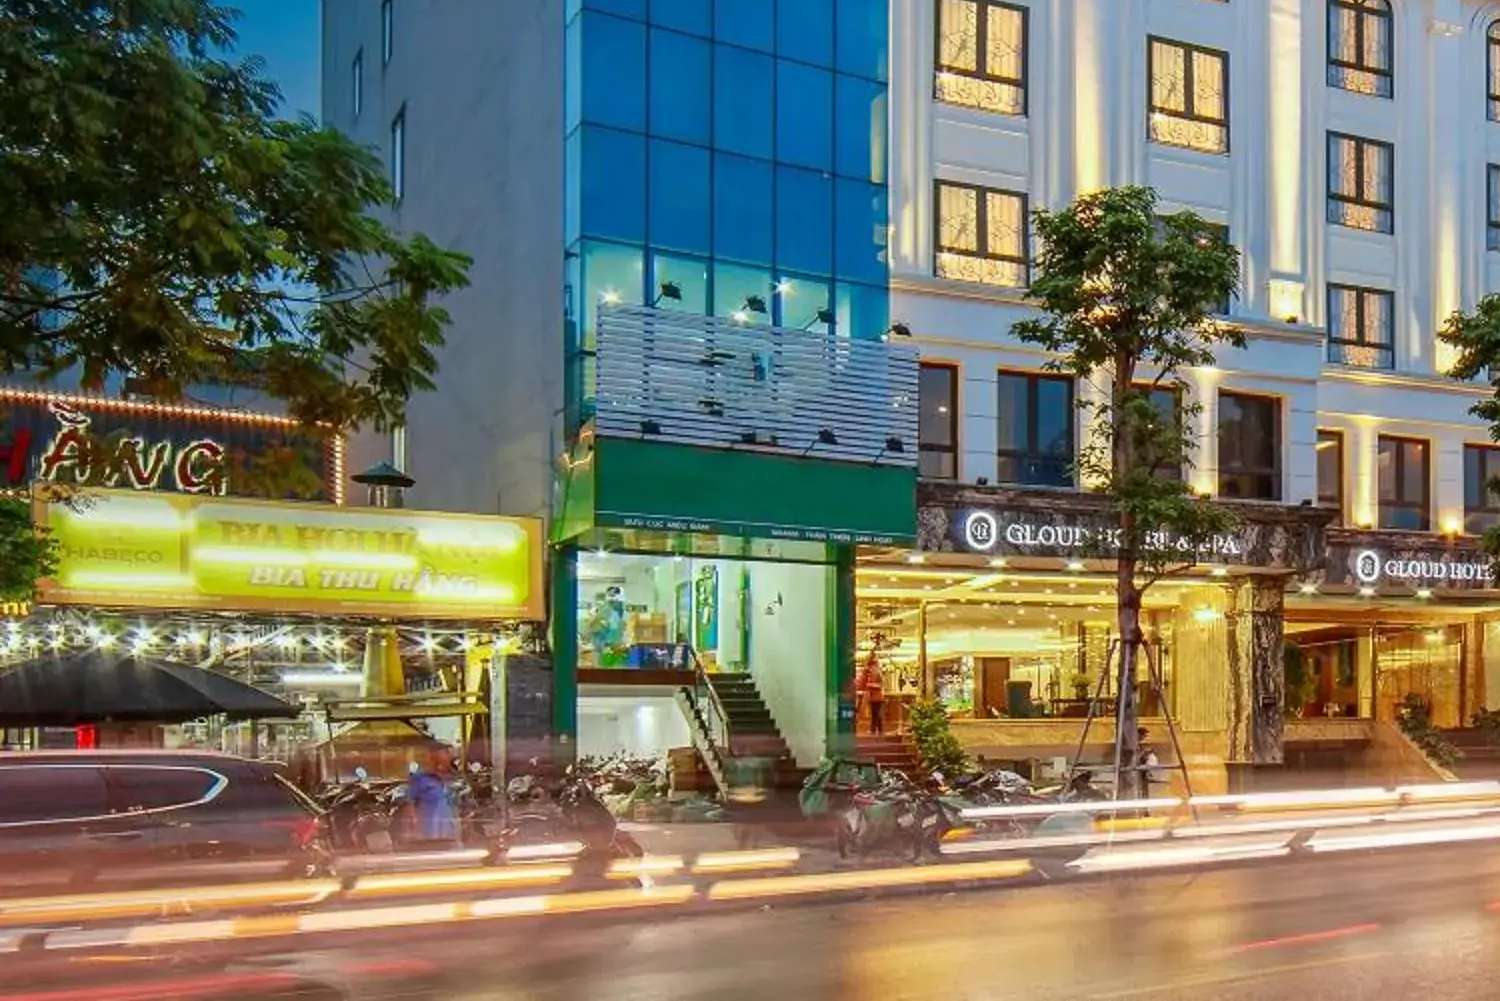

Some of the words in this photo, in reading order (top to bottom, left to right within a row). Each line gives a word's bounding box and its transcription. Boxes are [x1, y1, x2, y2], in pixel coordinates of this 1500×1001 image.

[249, 565, 308, 589] BIA
[320, 568, 380, 591] THU
[1385, 559, 1447, 579] GLOUD
